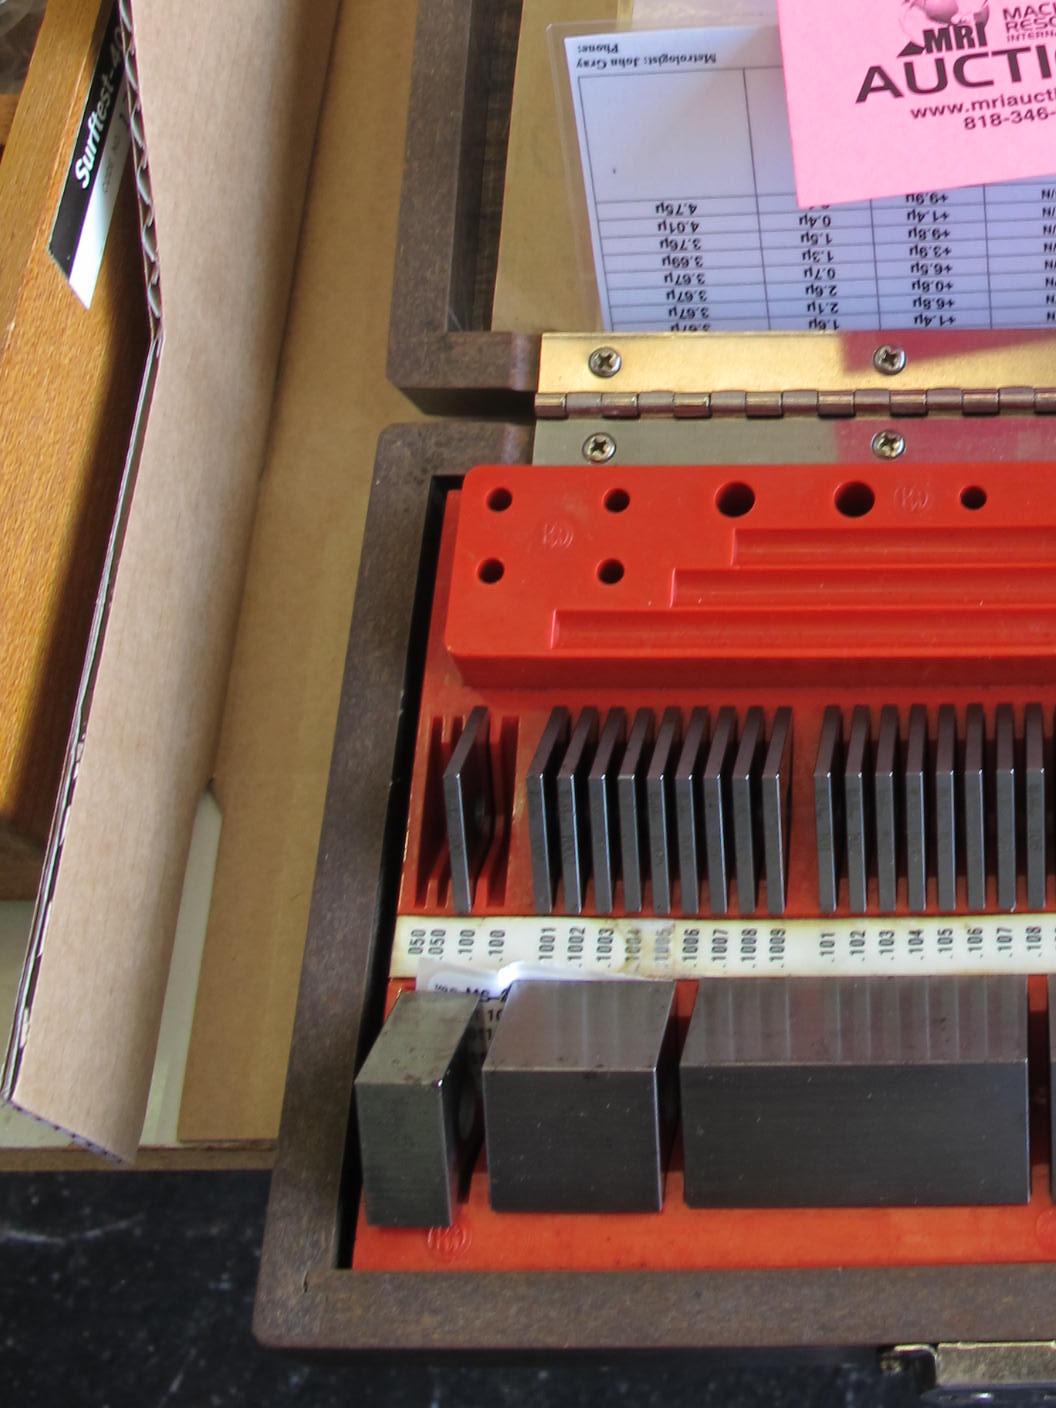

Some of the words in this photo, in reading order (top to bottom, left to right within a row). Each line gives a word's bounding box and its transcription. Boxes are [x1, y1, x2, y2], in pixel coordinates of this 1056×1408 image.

[922, 21, 988, 54] MRI
[577, 43, 619, 54] Phone:
[576, 57, 608, 70] Gray
[610, 56, 641, 68] John
[643, 52, 717, 66] Metrologist:
